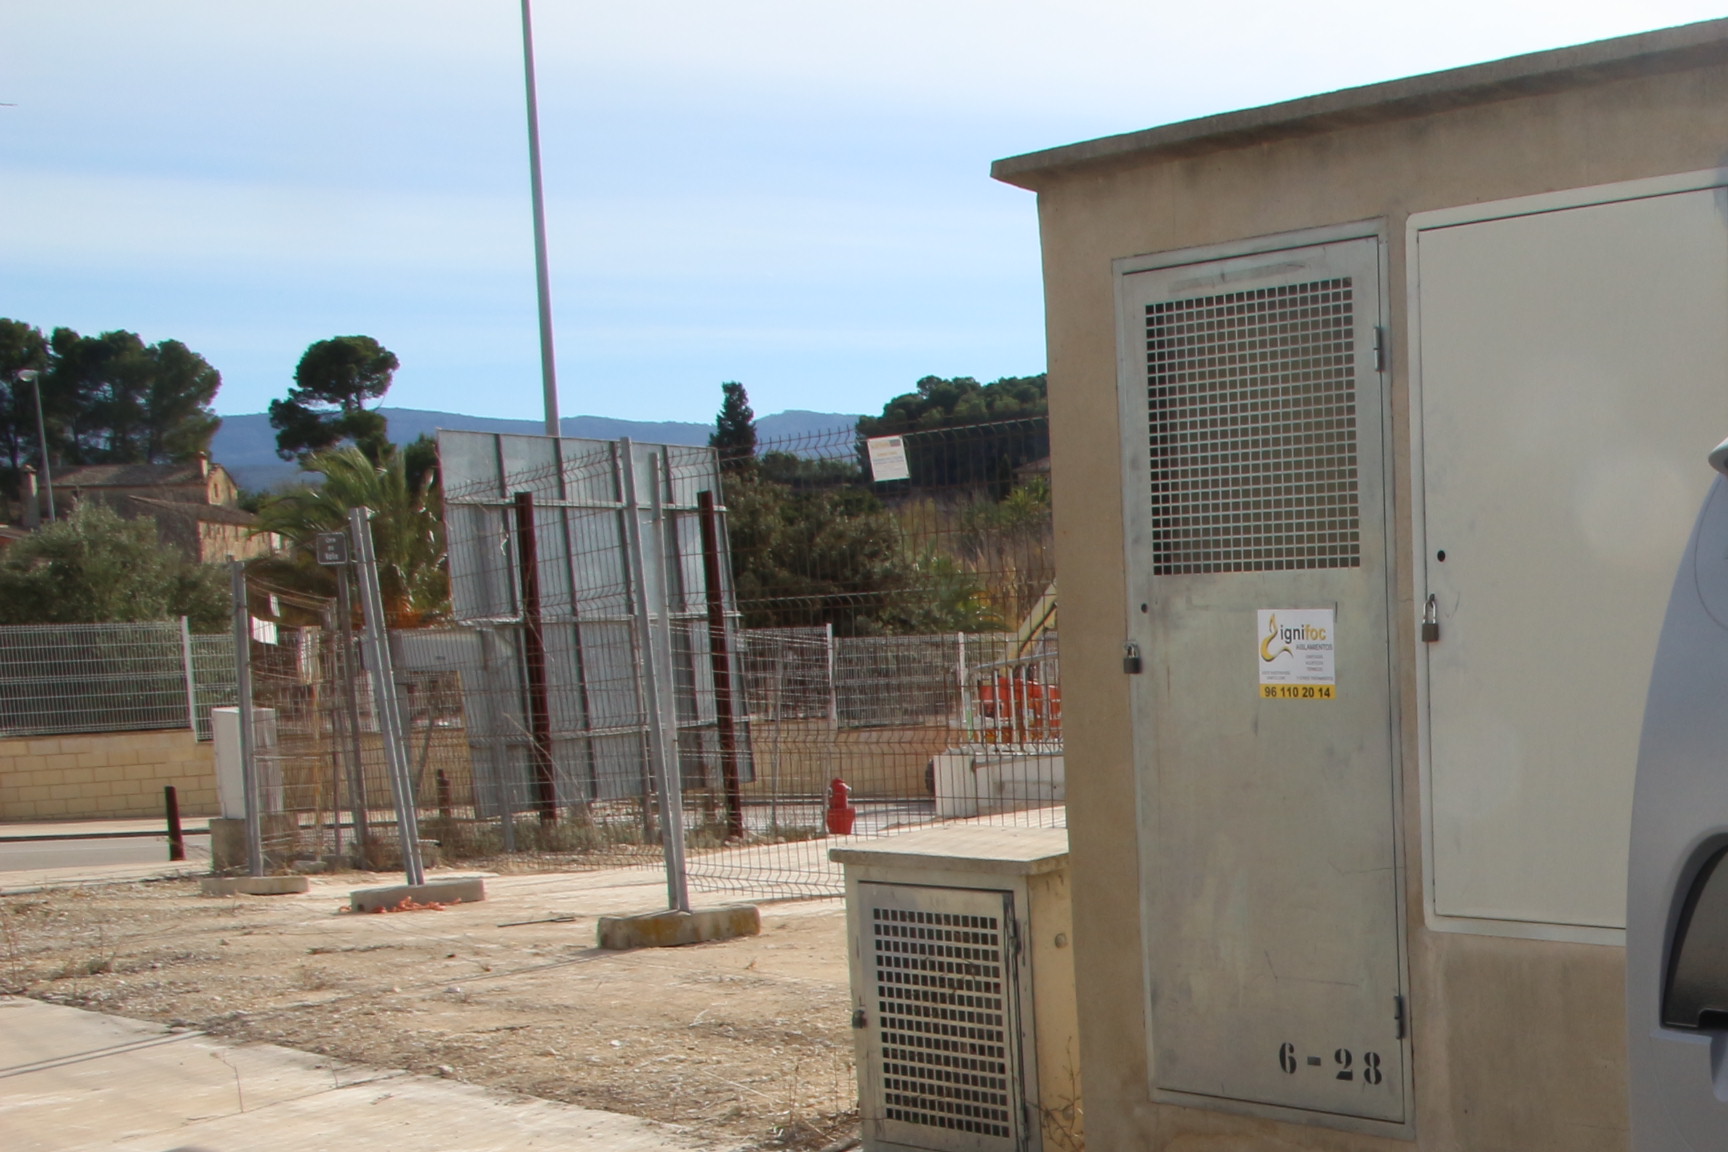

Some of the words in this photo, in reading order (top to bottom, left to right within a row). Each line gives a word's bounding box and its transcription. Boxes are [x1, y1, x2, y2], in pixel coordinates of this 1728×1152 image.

[1280, 624, 1327, 644] ignifoc
[1264, 686, 1277, 698] 96
[1280, 686, 1299, 698] 110
[1302, 687, 1315, 698] 20
[1318, 687, 1331, 698] 14
